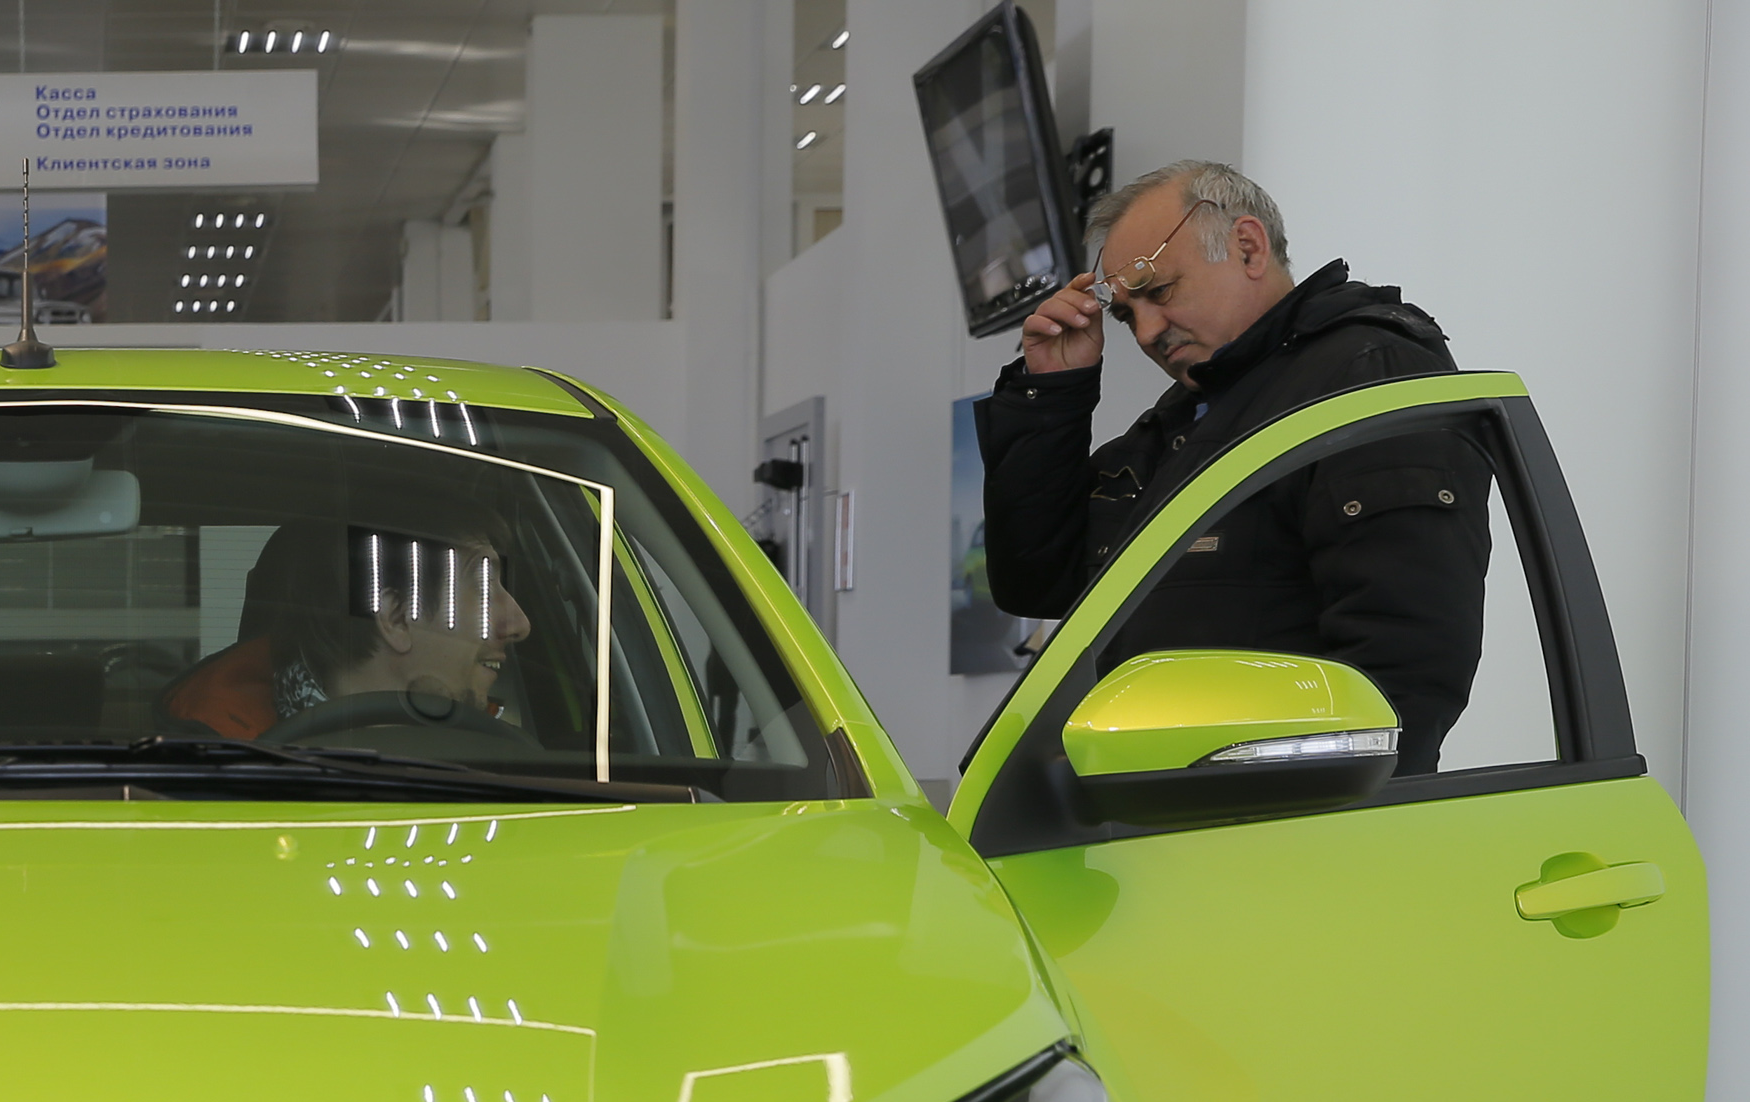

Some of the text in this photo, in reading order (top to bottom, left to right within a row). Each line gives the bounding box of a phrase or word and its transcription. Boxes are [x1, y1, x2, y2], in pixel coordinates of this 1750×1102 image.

[35, 86, 97, 101] Касса
[35, 104, 239, 121] Отдел страхования
[35, 122, 254, 141] Отдел кредитования
[35, 155, 212, 172] Клиентская зона
